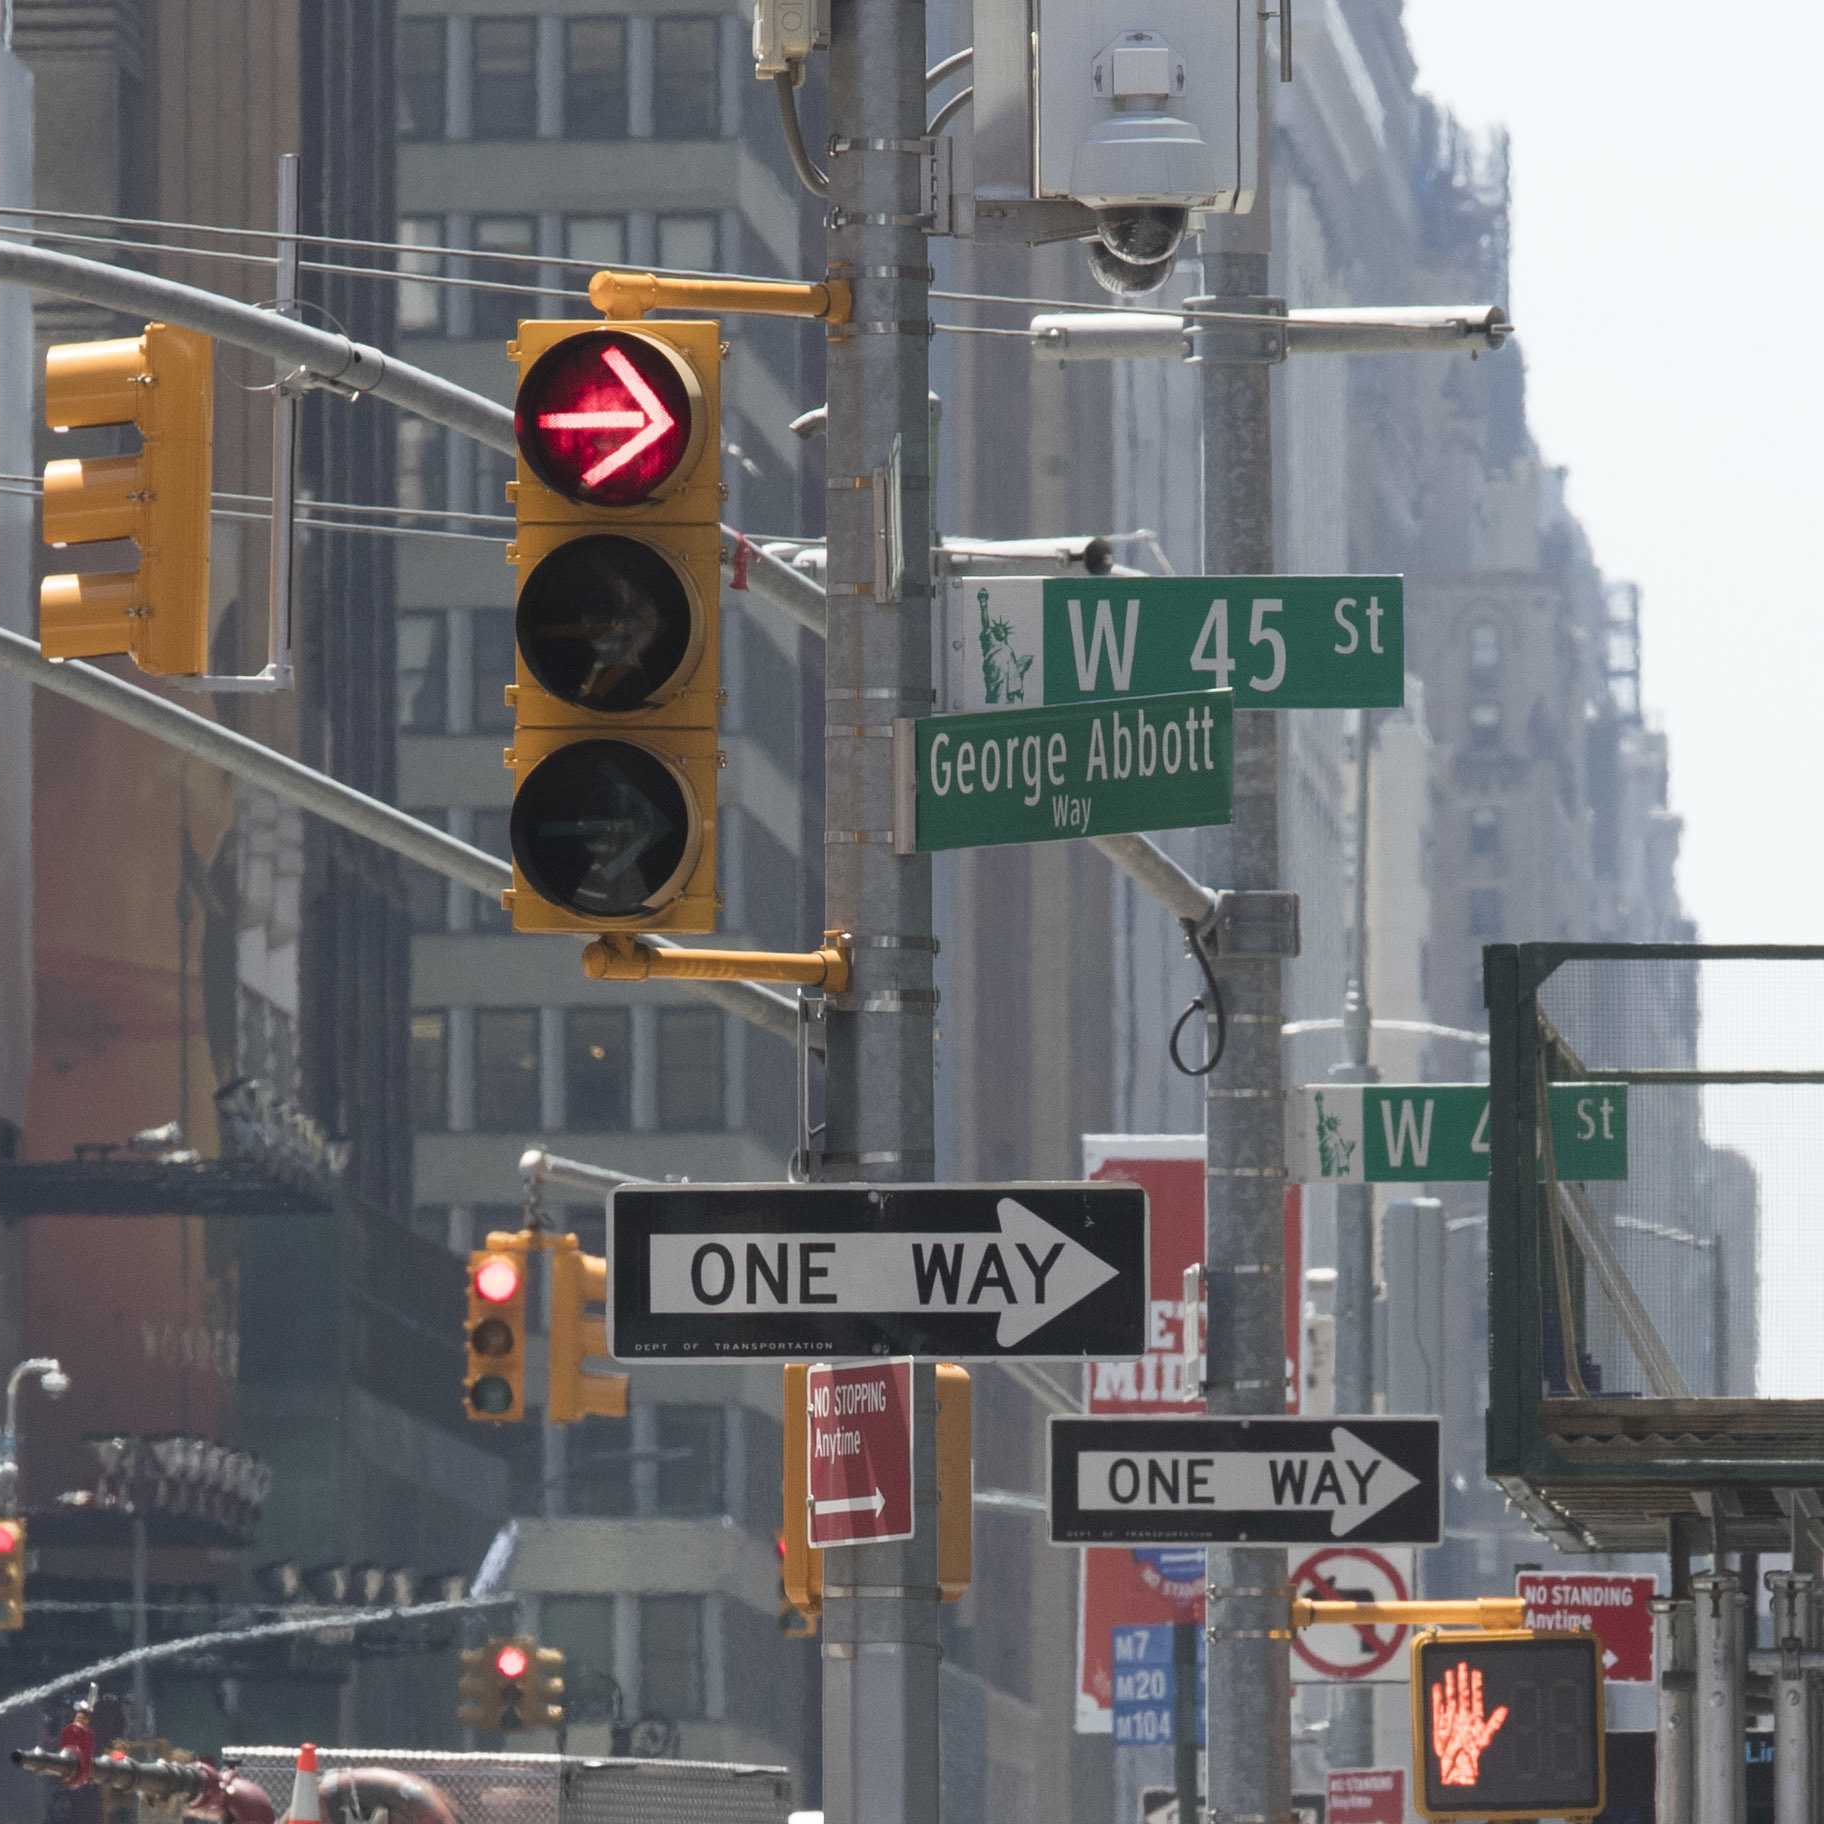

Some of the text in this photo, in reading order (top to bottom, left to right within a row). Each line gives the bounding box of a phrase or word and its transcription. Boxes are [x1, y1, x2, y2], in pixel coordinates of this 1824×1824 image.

[1066, 596, 1384, 693] W 45 St
[930, 705, 1214, 807] George Abbott
[1052, 792, 1092, 835] Way
[1381, 1099, 1434, 1168] W
[1577, 1097, 1615, 1141] St
[690, 1242, 1065, 1306] ONE WAY
[635, 1341, 834, 1351] DEPT OF TRANSPORTATION
[814, 1380, 887, 1418] NO STOPPING
[815, 1428, 860, 1464] Anytime
[1108, 1458, 1382, 1506] ONE WAY
[1526, 1586, 1633, 1607] NO STANDING
[1116, 1631, 1150, 1662] M7
[1116, 1673, 1165, 1700] M20
[1117, 1710, 1171, 1741] M104
